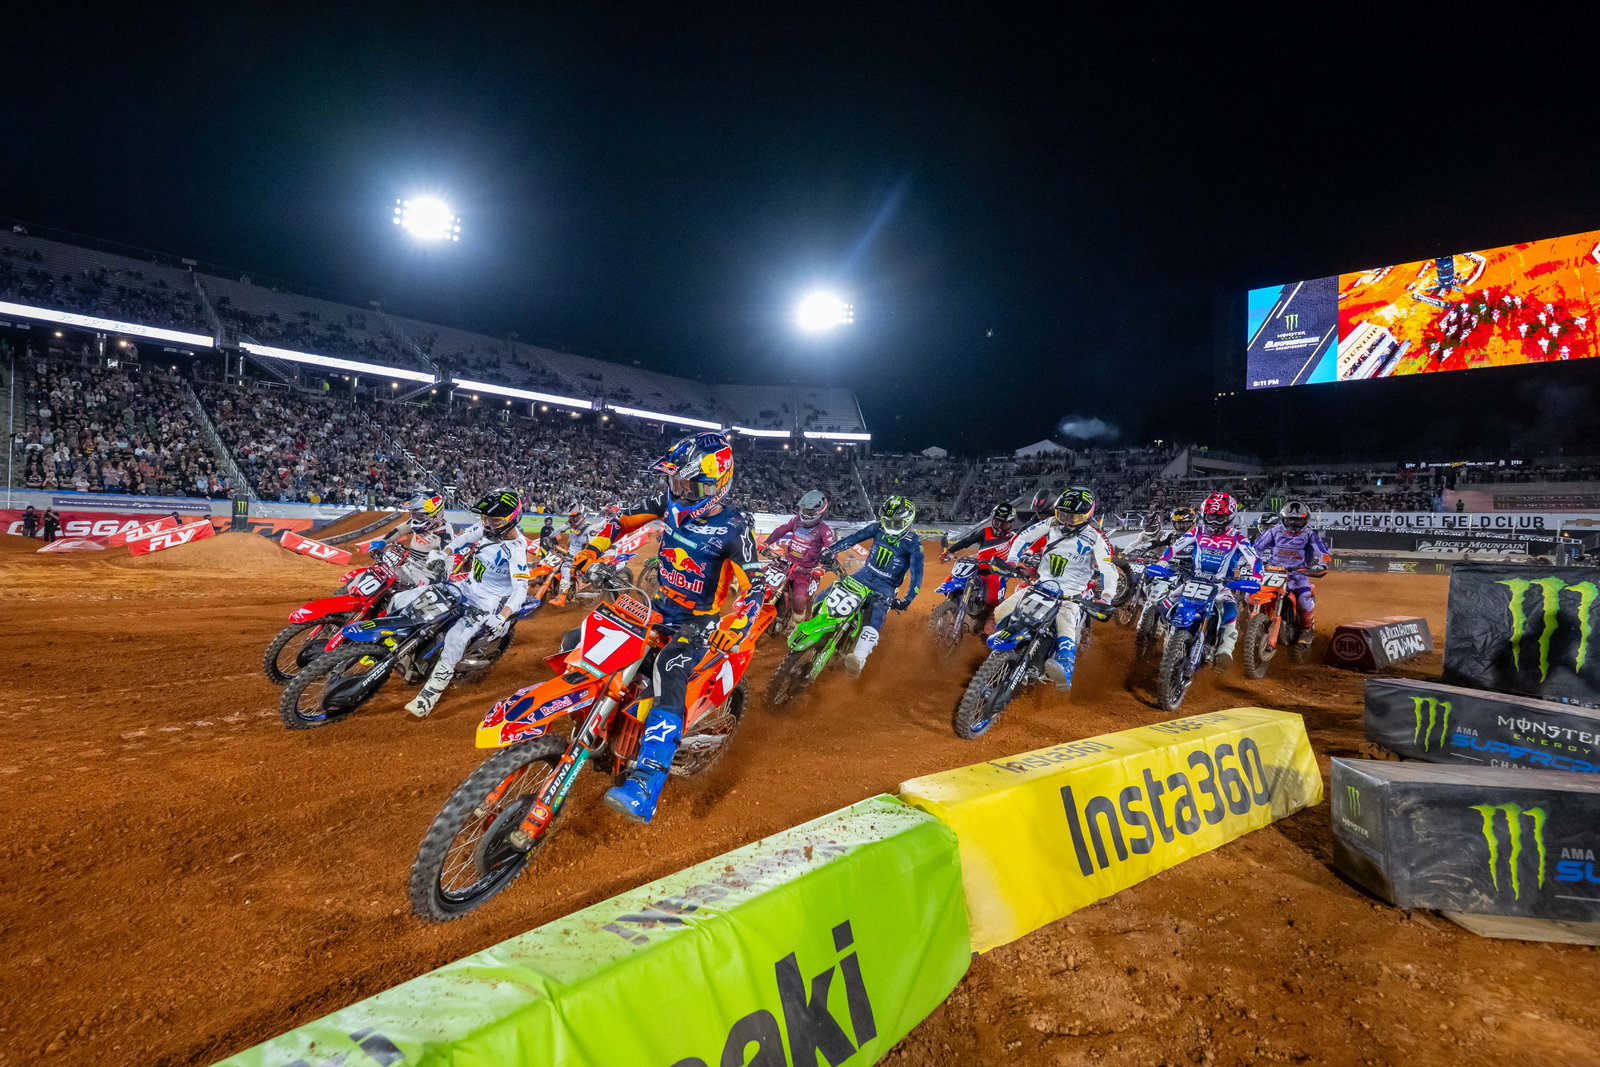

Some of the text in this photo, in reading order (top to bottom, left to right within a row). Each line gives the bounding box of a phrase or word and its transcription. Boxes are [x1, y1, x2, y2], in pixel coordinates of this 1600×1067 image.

[1343, 327, 1378, 364] DUNLOP
[1342, 515, 1436, 527] CHEVROLET
[1441, 516, 1491, 528] FIELD
[1495, 516, 1545, 528] CLUB
[126, 522, 162, 543] FLY
[149, 529, 196, 551] FLY
[297, 540, 338, 558] FLY
[1467, 542, 1526, 550] MOUNTAIN
[764, 567, 787, 587] 59
[954, 563, 976, 576] 87
[1263, 573, 1287, 587] 75
[358, 575, 381, 597] 10
[675, 573, 704, 594] Bull
[1182, 582, 1213, 600] 92
[621, 596, 649, 614] RENTHA
[827, 587, 859, 616] 56
[584, 626, 631, 665] 1
[362, 661, 392, 687] DUNLOP
[716, 660, 734, 695] 1
[1456, 726, 1478, 736] AMA
[1513, 733, 1591, 755] ENERGY
[990, 740, 1115, 774] Insta360
[561, 758, 587, 796] MOTOREX
[1061, 737, 1271, 877] Insta360
[1561, 847, 1596, 861] AMA
[668, 919, 877, 1067] aki
